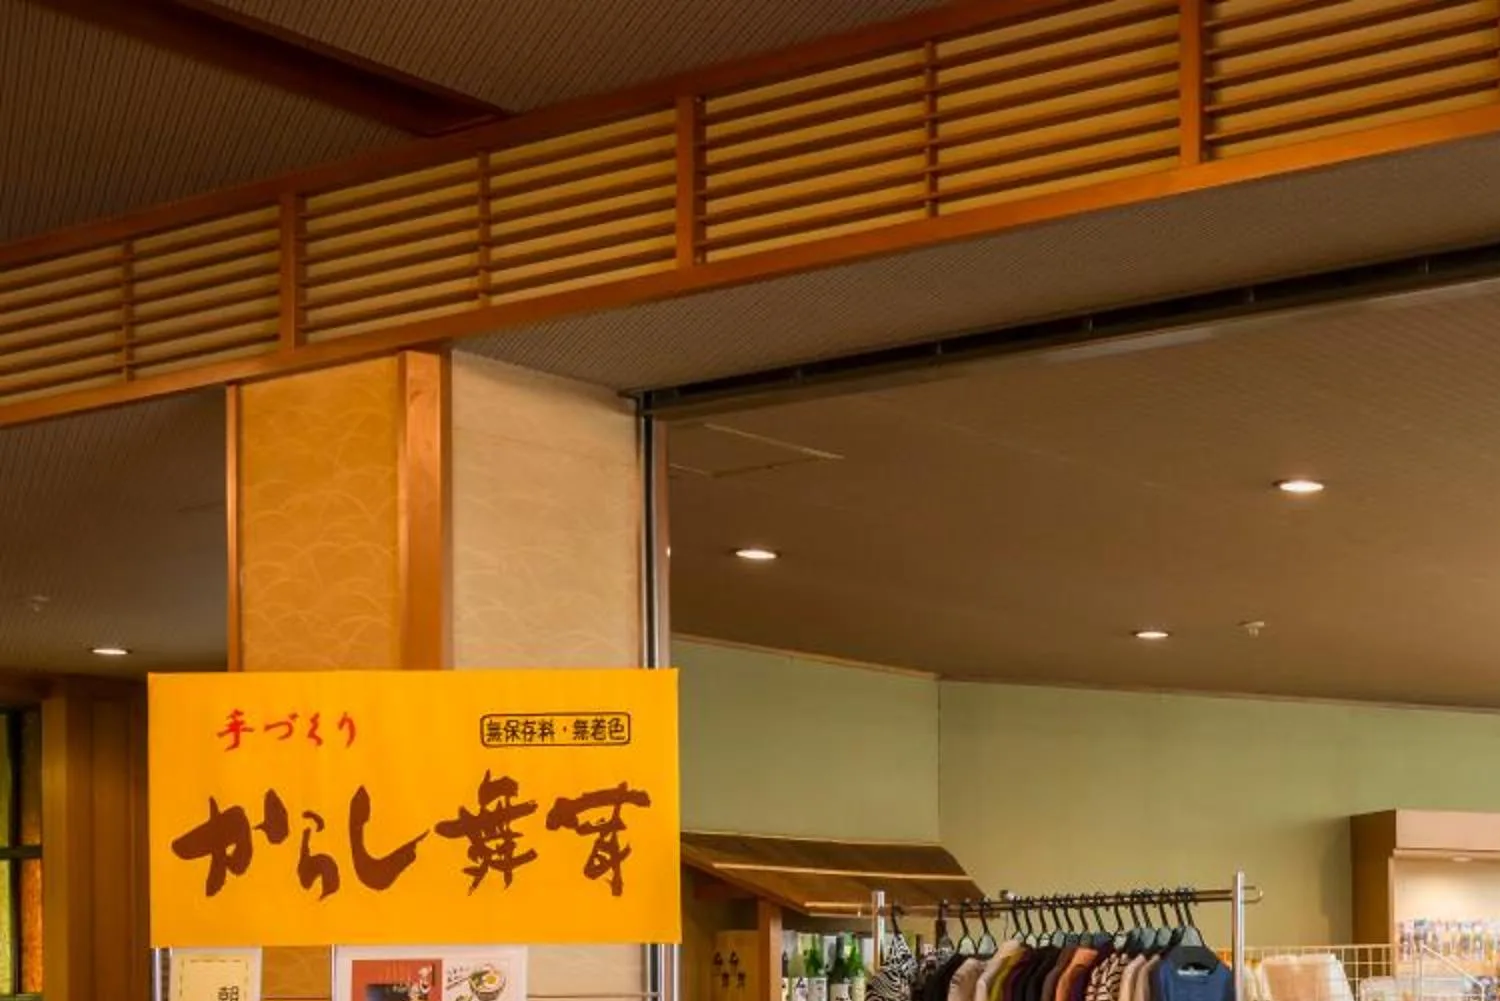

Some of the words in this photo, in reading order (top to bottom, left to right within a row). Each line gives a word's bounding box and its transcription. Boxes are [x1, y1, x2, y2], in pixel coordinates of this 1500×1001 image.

[216, 708, 358, 752] 手づくり
[486, 718, 627, 742] 無保存料・無着色
[171, 769, 651, 899] からし舞茸
